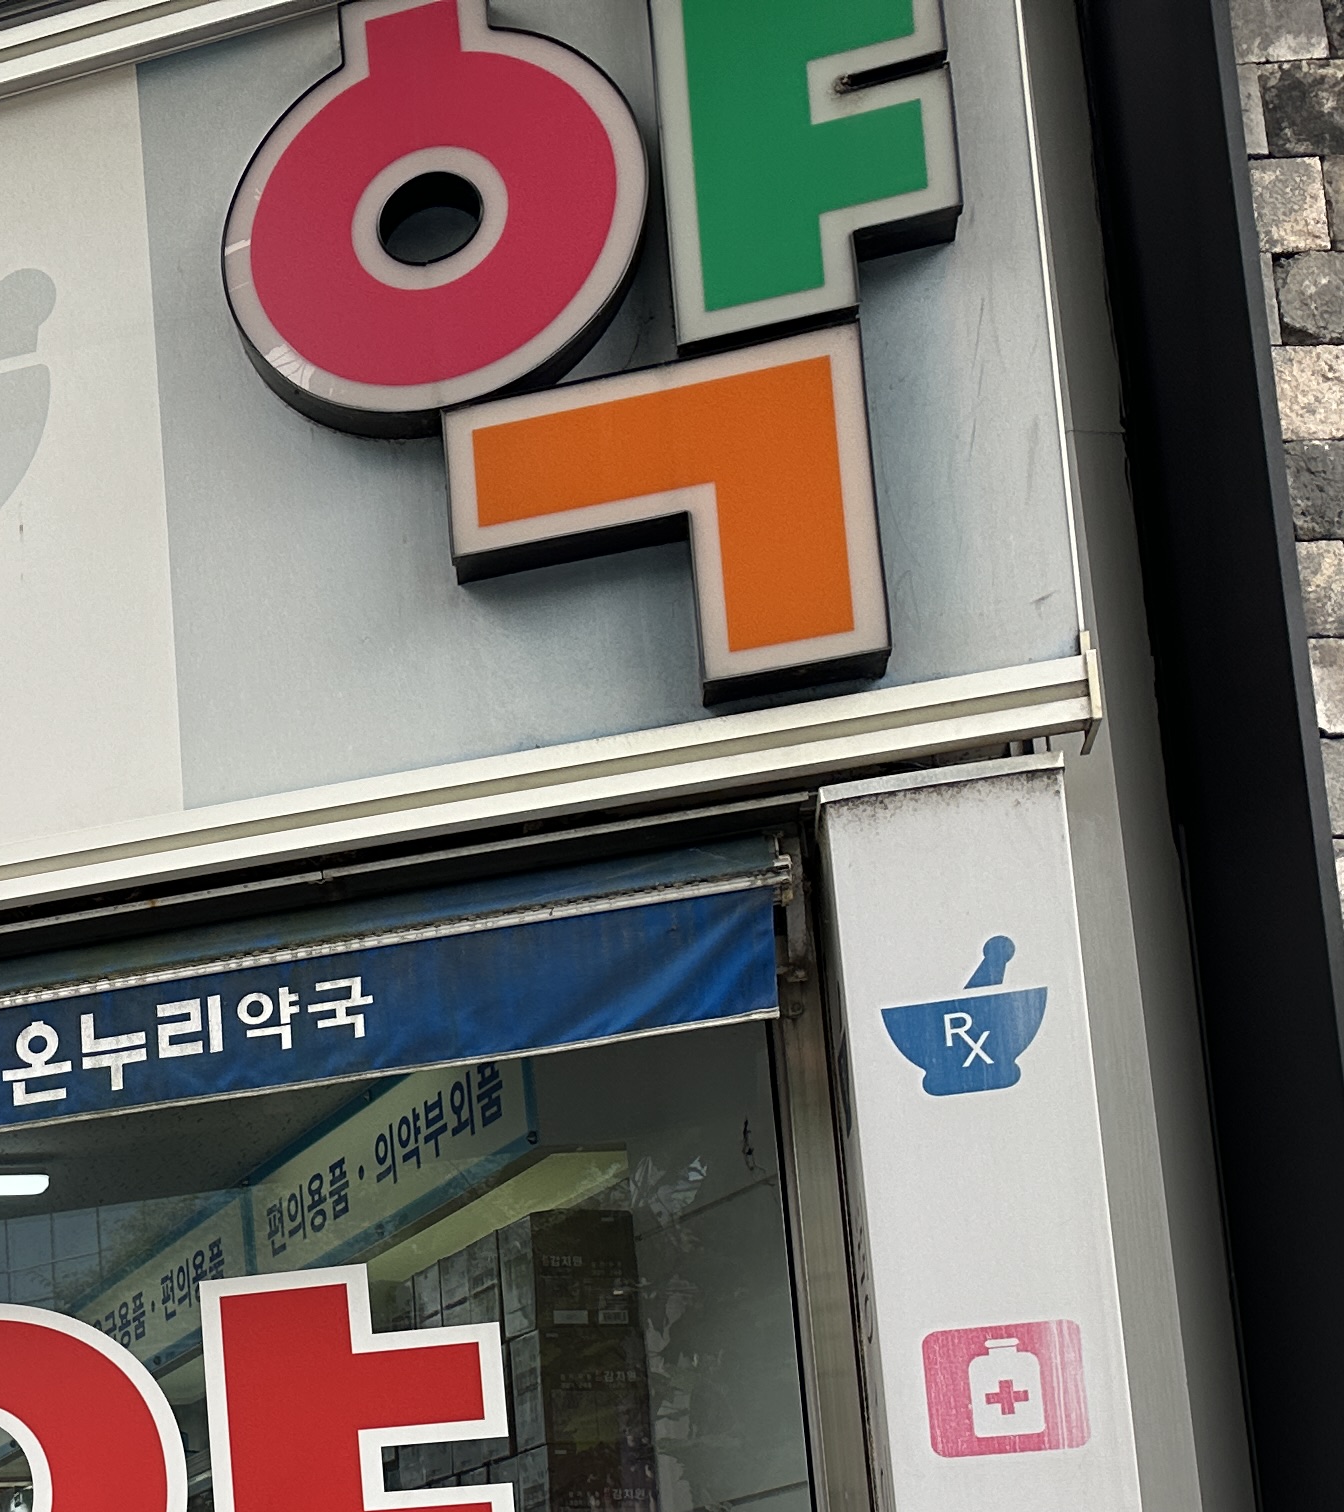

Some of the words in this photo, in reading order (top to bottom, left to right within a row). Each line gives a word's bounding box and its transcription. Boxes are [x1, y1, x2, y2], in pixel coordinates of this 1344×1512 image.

[222, 0, 963, 705] 약
[2, 996, 224, 1107] 온누리
[237, 975, 375, 1050] 약국
